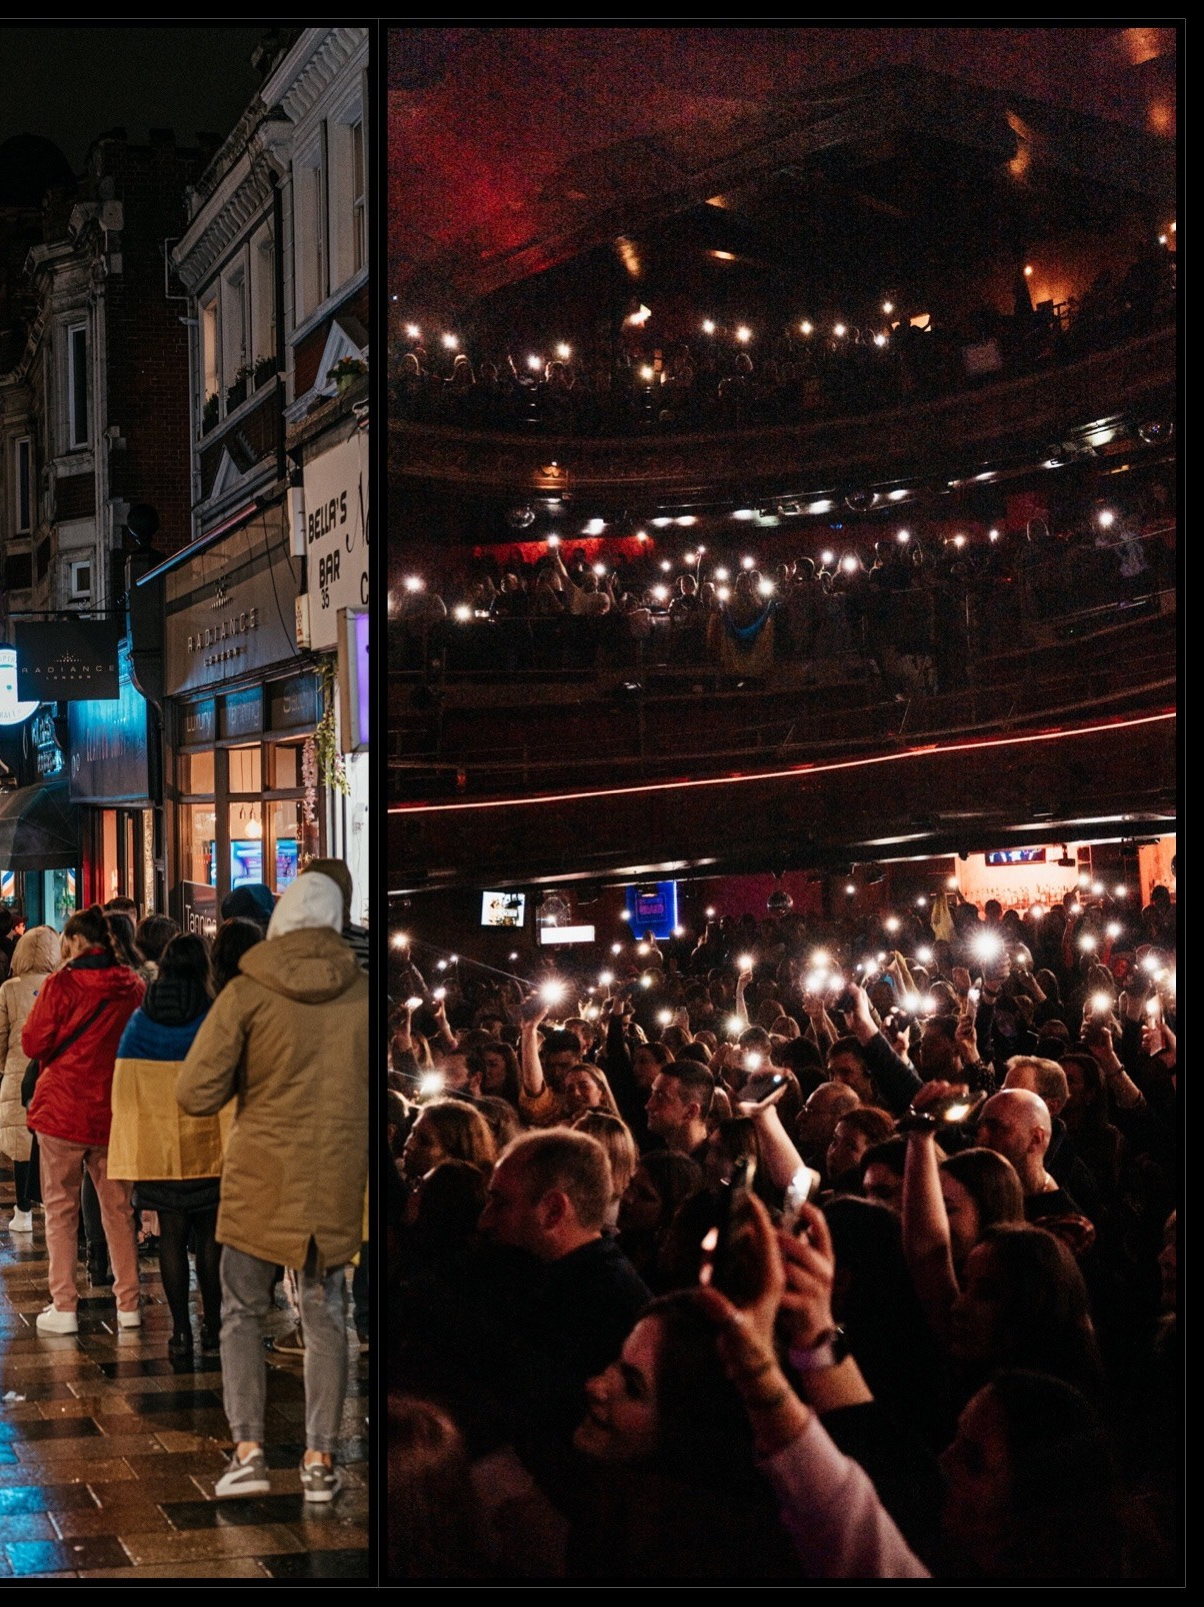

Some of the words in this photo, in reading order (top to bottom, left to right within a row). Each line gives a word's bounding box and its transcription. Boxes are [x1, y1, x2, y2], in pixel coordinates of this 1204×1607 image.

[308, 490, 347, 544] BELLA'S
[319, 549, 340, 590] BAR
[187, 607, 258, 654] RADIANCE
[21, 665, 115, 674] RADIANCE
